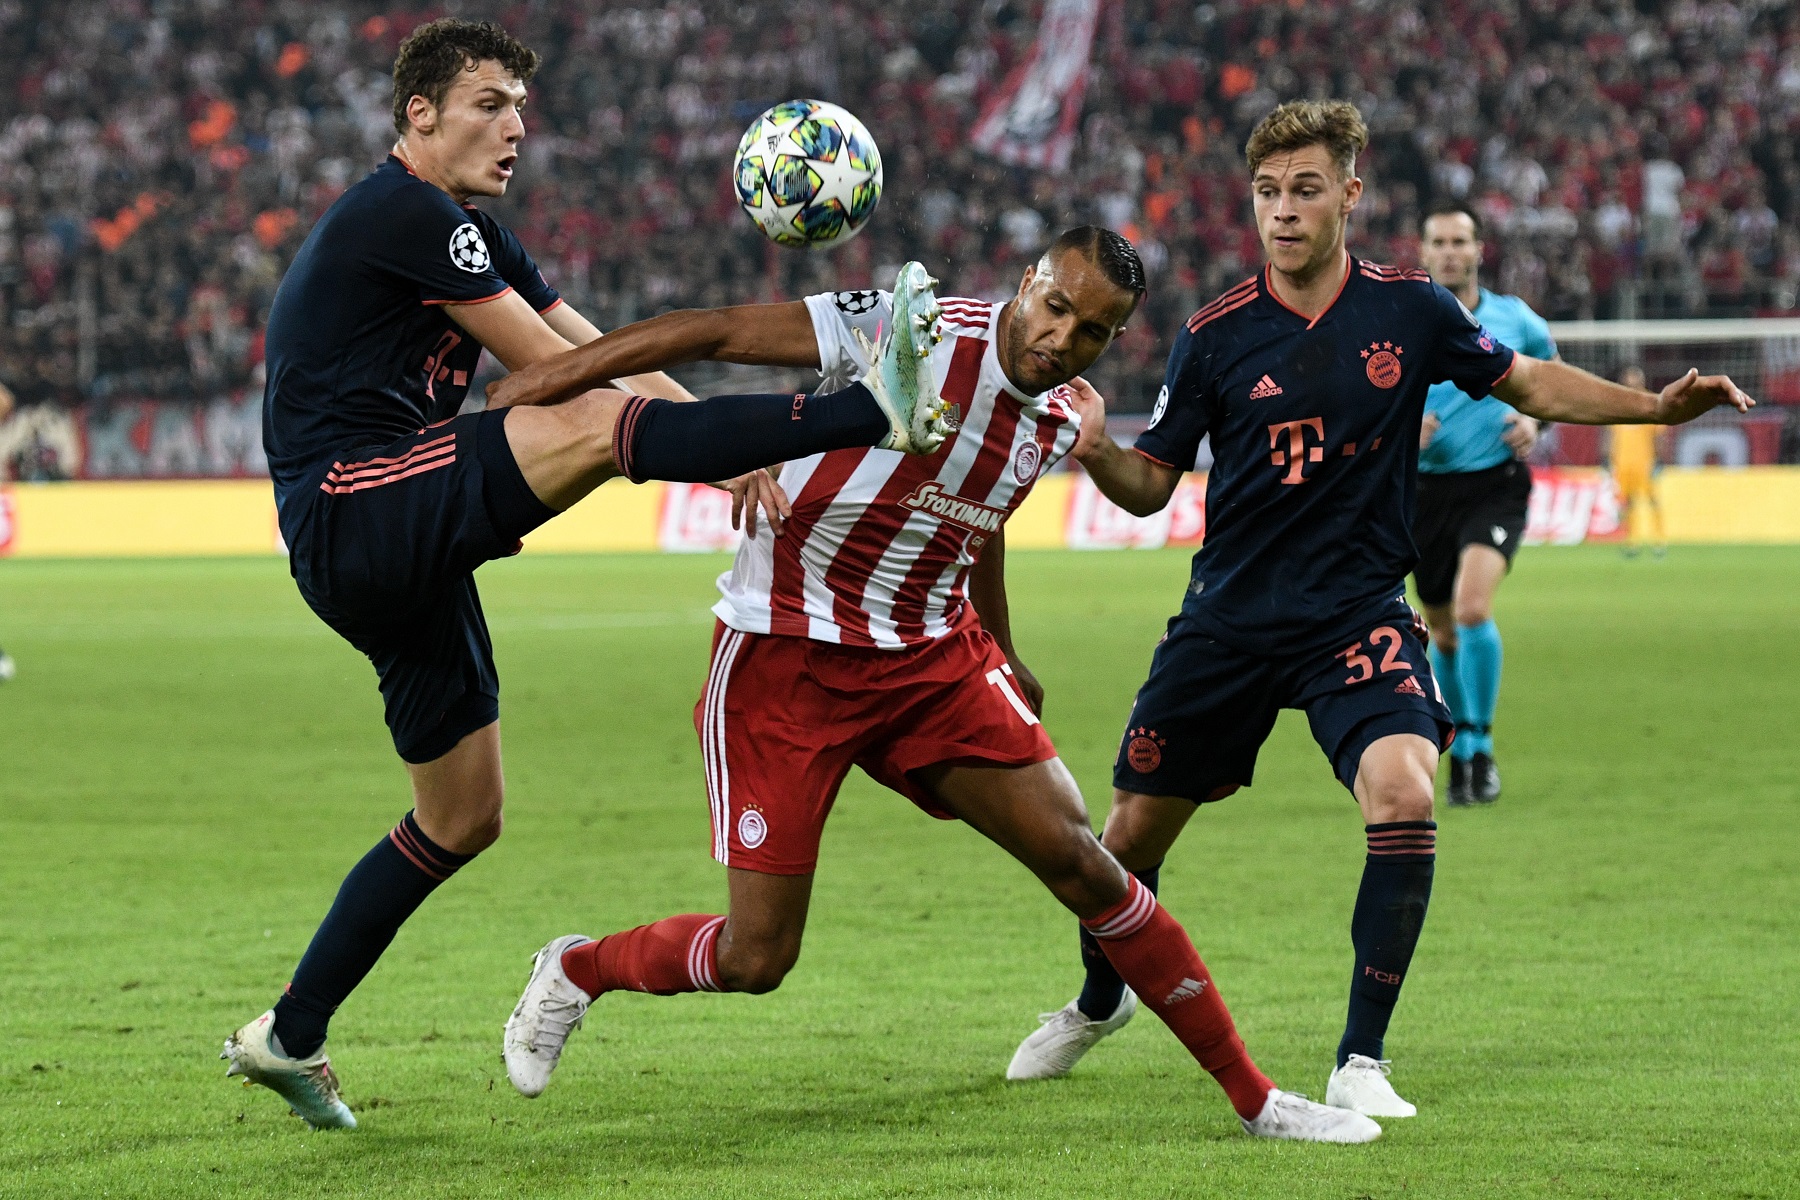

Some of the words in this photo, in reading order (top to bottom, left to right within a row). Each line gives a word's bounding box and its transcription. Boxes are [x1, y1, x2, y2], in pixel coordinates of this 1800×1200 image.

[1250, 386, 1283, 400] adidas
[791, 393, 806, 421] FCB
[1267, 416, 1325, 485] T
[906, 485, 1004, 533] STOIXIMAN
[1394, 687, 1426, 698] adidas
[1364, 965, 1401, 985] FCB
